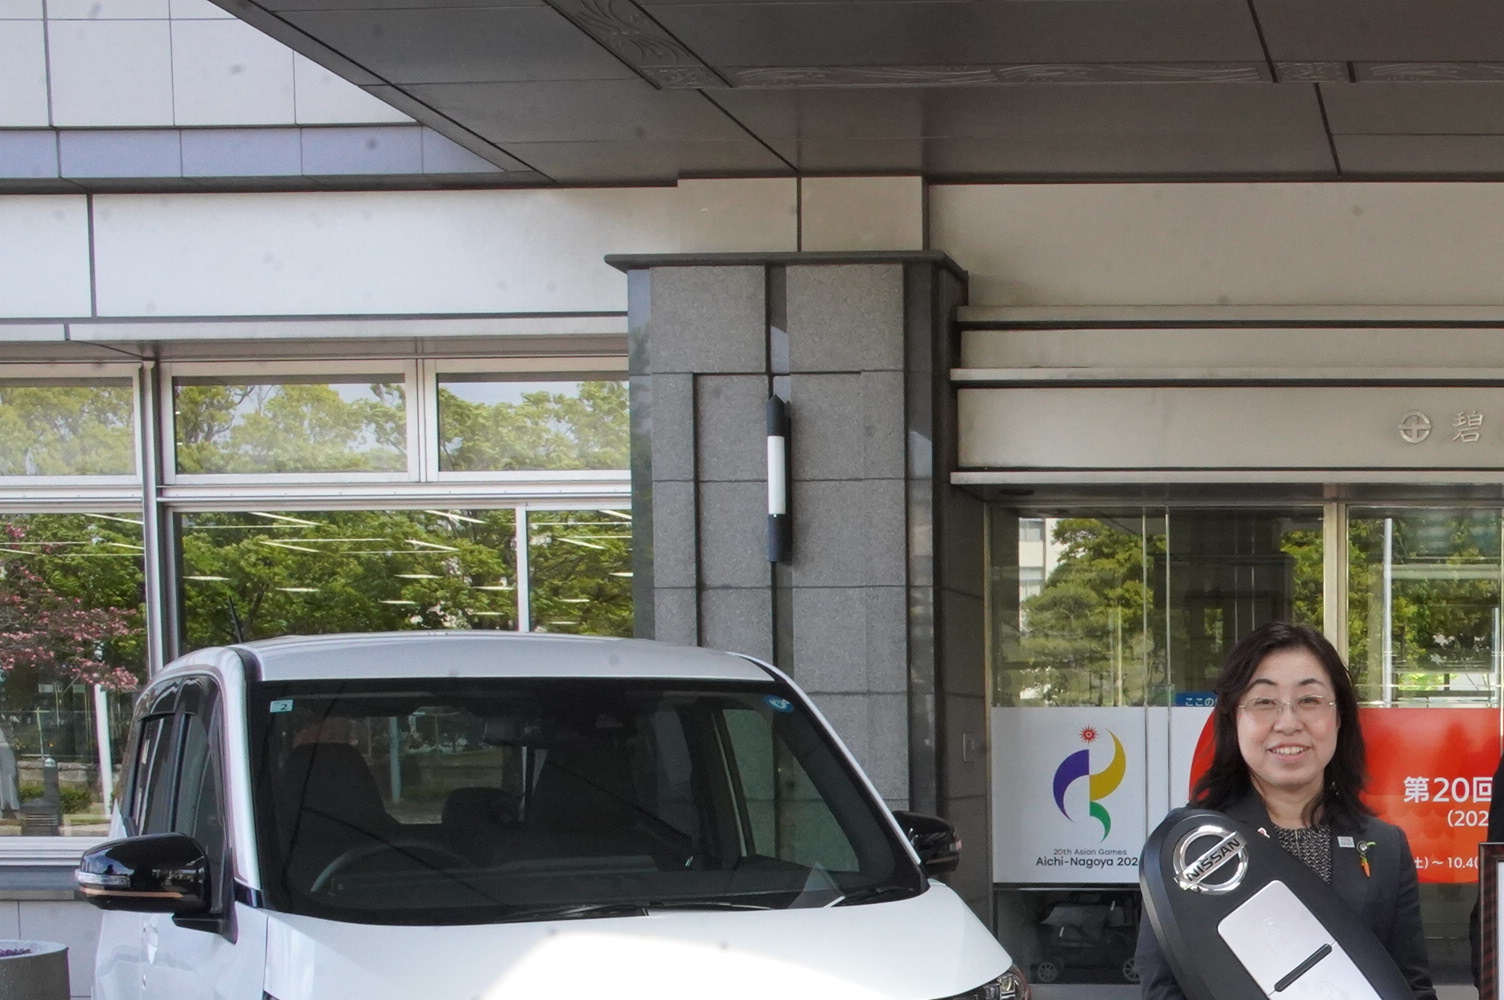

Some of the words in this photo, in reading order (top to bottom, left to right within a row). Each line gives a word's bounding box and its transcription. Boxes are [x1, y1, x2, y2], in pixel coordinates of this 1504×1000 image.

[1185, 697, 1218, 707] ここの
[1403, 776, 1493, 803] 第20回
[1053, 848, 1072, 856] 20th
[1074, 848, 1097, 856] Asian
[1098, 848, 1127, 856] Games
[1036, 856, 1114, 869] Aichi-Nagoya
[1185, 838, 1241, 882] NISSAN
